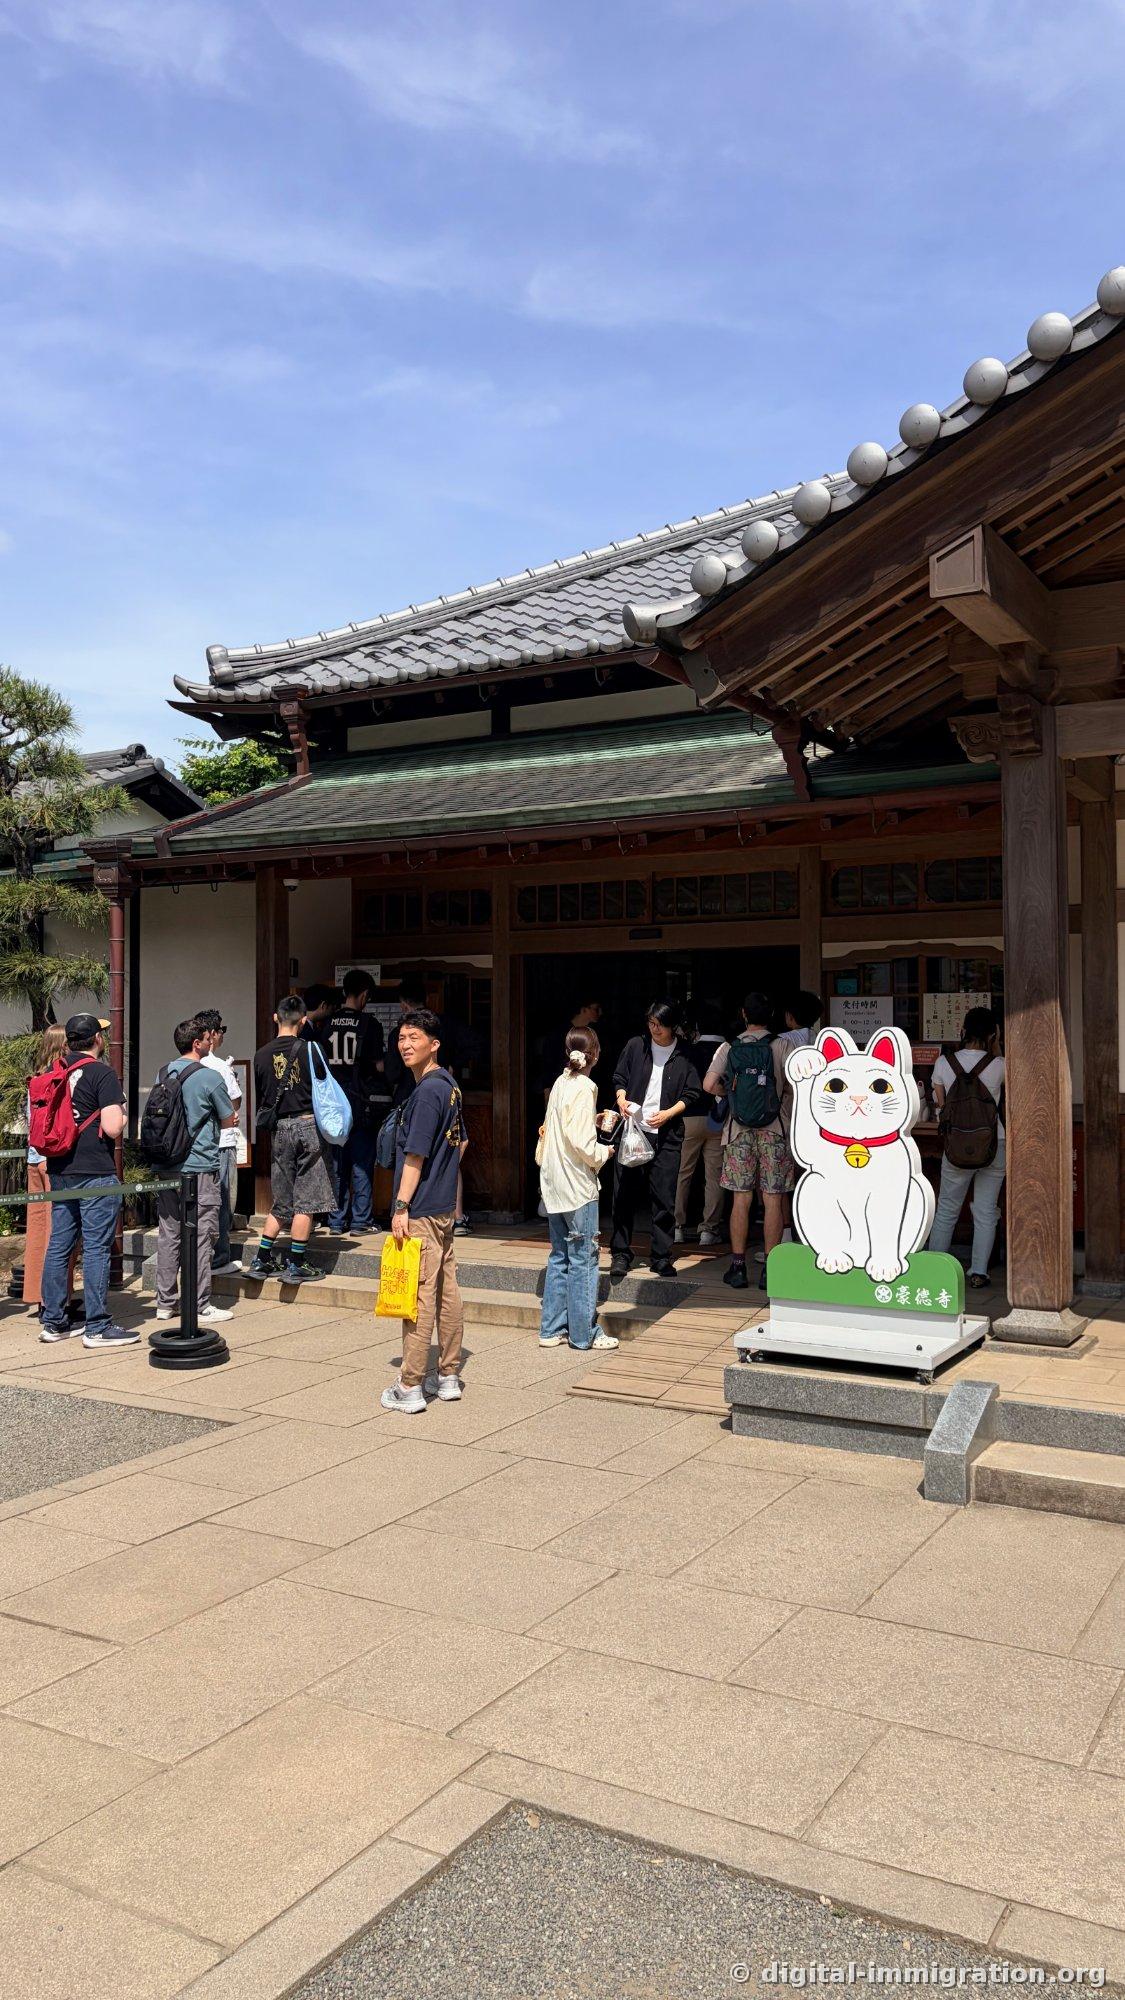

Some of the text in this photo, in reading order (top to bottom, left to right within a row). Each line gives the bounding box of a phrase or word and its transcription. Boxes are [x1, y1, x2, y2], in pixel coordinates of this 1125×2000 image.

[842, 1000, 878, 1009] 受付時間
[328, 1031, 358, 1065] 10
